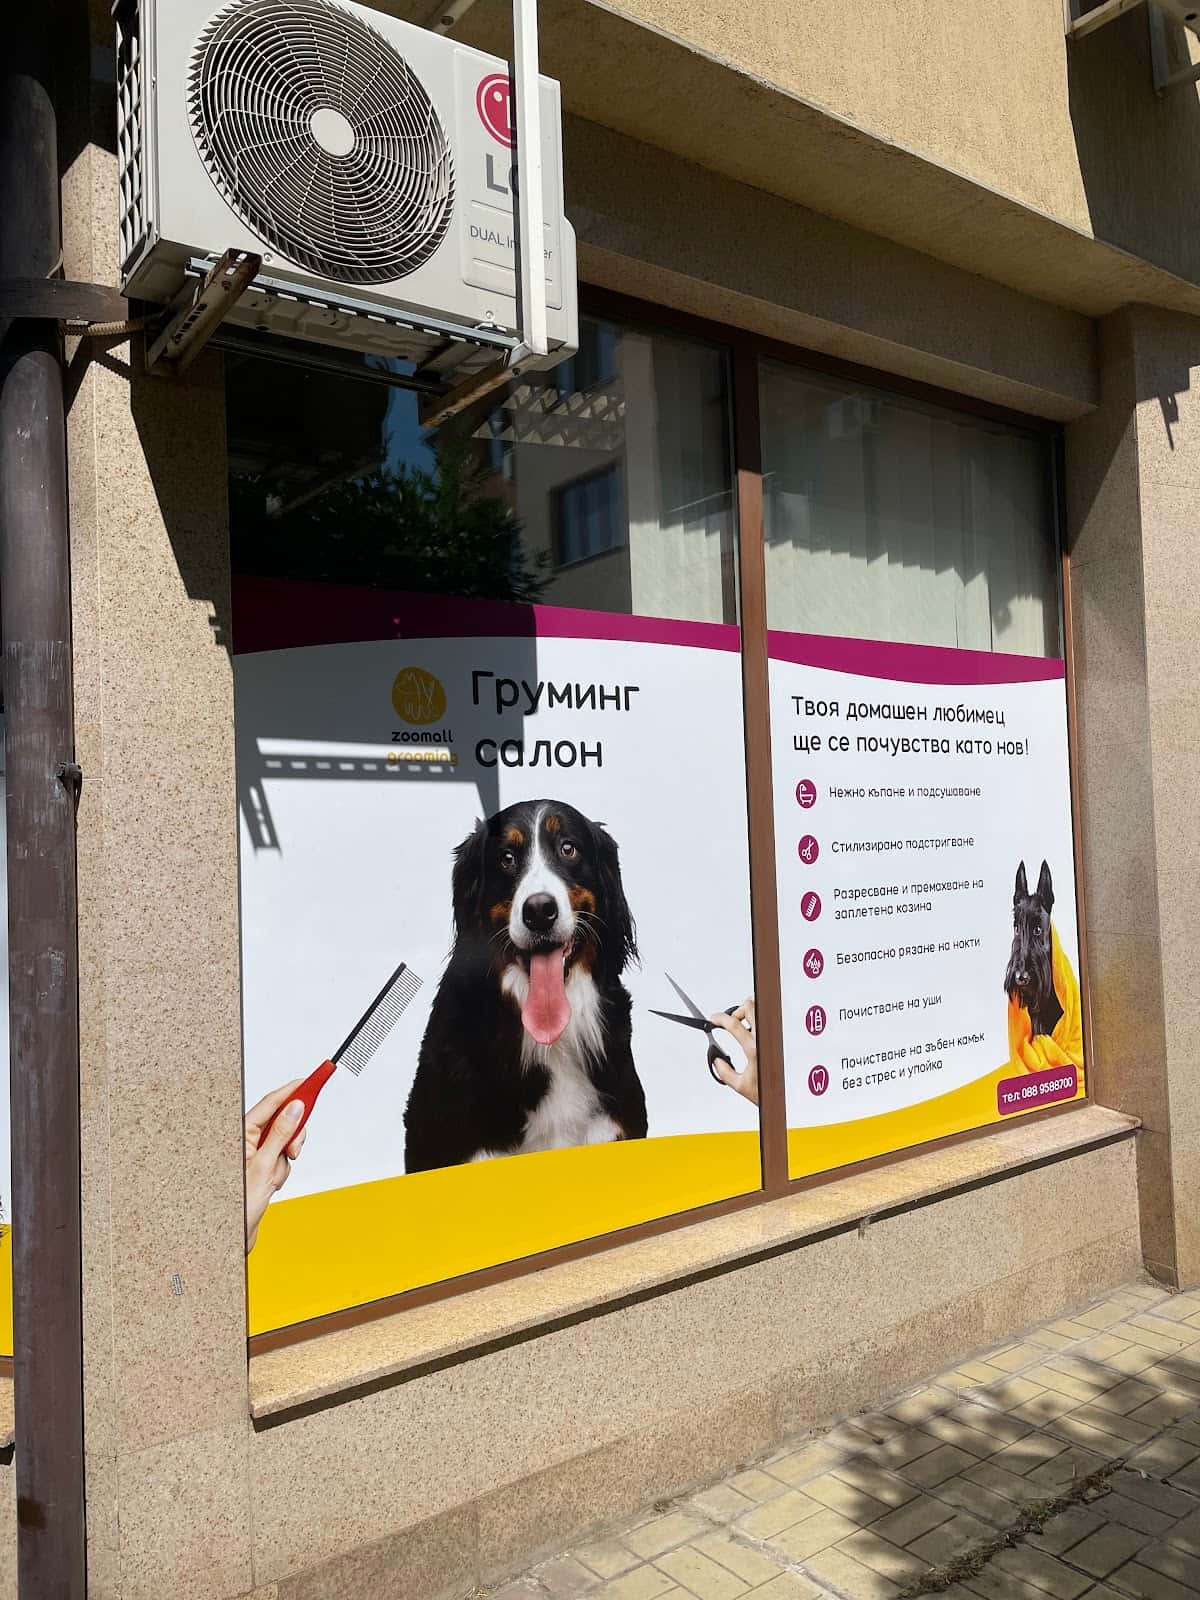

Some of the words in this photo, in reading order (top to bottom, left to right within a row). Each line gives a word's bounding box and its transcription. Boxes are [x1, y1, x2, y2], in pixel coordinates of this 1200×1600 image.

[470, 225, 505, 246] DUAL
[471, 670, 640, 716] Груминг
[791, 695, 840, 717] Твоя
[846, 702, 927, 721] домашен
[932, 704, 1006, 727] любимец
[391, 729, 454, 743] zoomall
[793, 735, 821, 753] ще
[828, 736, 850, 751] се
[856, 736, 951, 757] почувства
[955, 740, 993, 755] като
[996, 738, 1030, 756] нов!
[386, 751, 458, 766] grooming
[475, 738, 603, 768] салон
[829, 786, 866, 798] Нежно
[868, 786, 906, 798] къпане
[908, 787, 915, 797] и
[917, 786, 982, 799] подсушаване
[831, 841, 904, 853] Стилизирано
[905, 836, 975, 851] подстригване
[833, 884, 899, 901] Разресване
[902, 884, 909, 895] и
[911, 879, 970, 896] премахване
[972, 878, 984, 889] на
[835, 903, 894, 920] заплетена
[896, 900, 932, 914] козина
[836, 948, 896, 965] Безопасно
[898, 945, 936, 960] рязане
[938, 941, 951, 953] на
[953, 936, 981, 950] нокти
[839, 999, 905, 1021] Почистване
[907, 996, 920, 1009] на
[922, 993, 942, 1009] уши
[841, 1047, 907, 1070] Почистване
[909, 1044, 922, 1056] на
[925, 1037, 955, 1053] зъбен
[957, 1031, 985, 1047] камък
[842, 1074, 863, 1090] без
[865, 1068, 897, 1087] стрес
[899, 1067, 906, 1077] и
[907, 1058, 943, 1078] упойка
[1021, 1085, 1038, 1099] 088
[1039, 1076, 1073, 1095] 9588700
